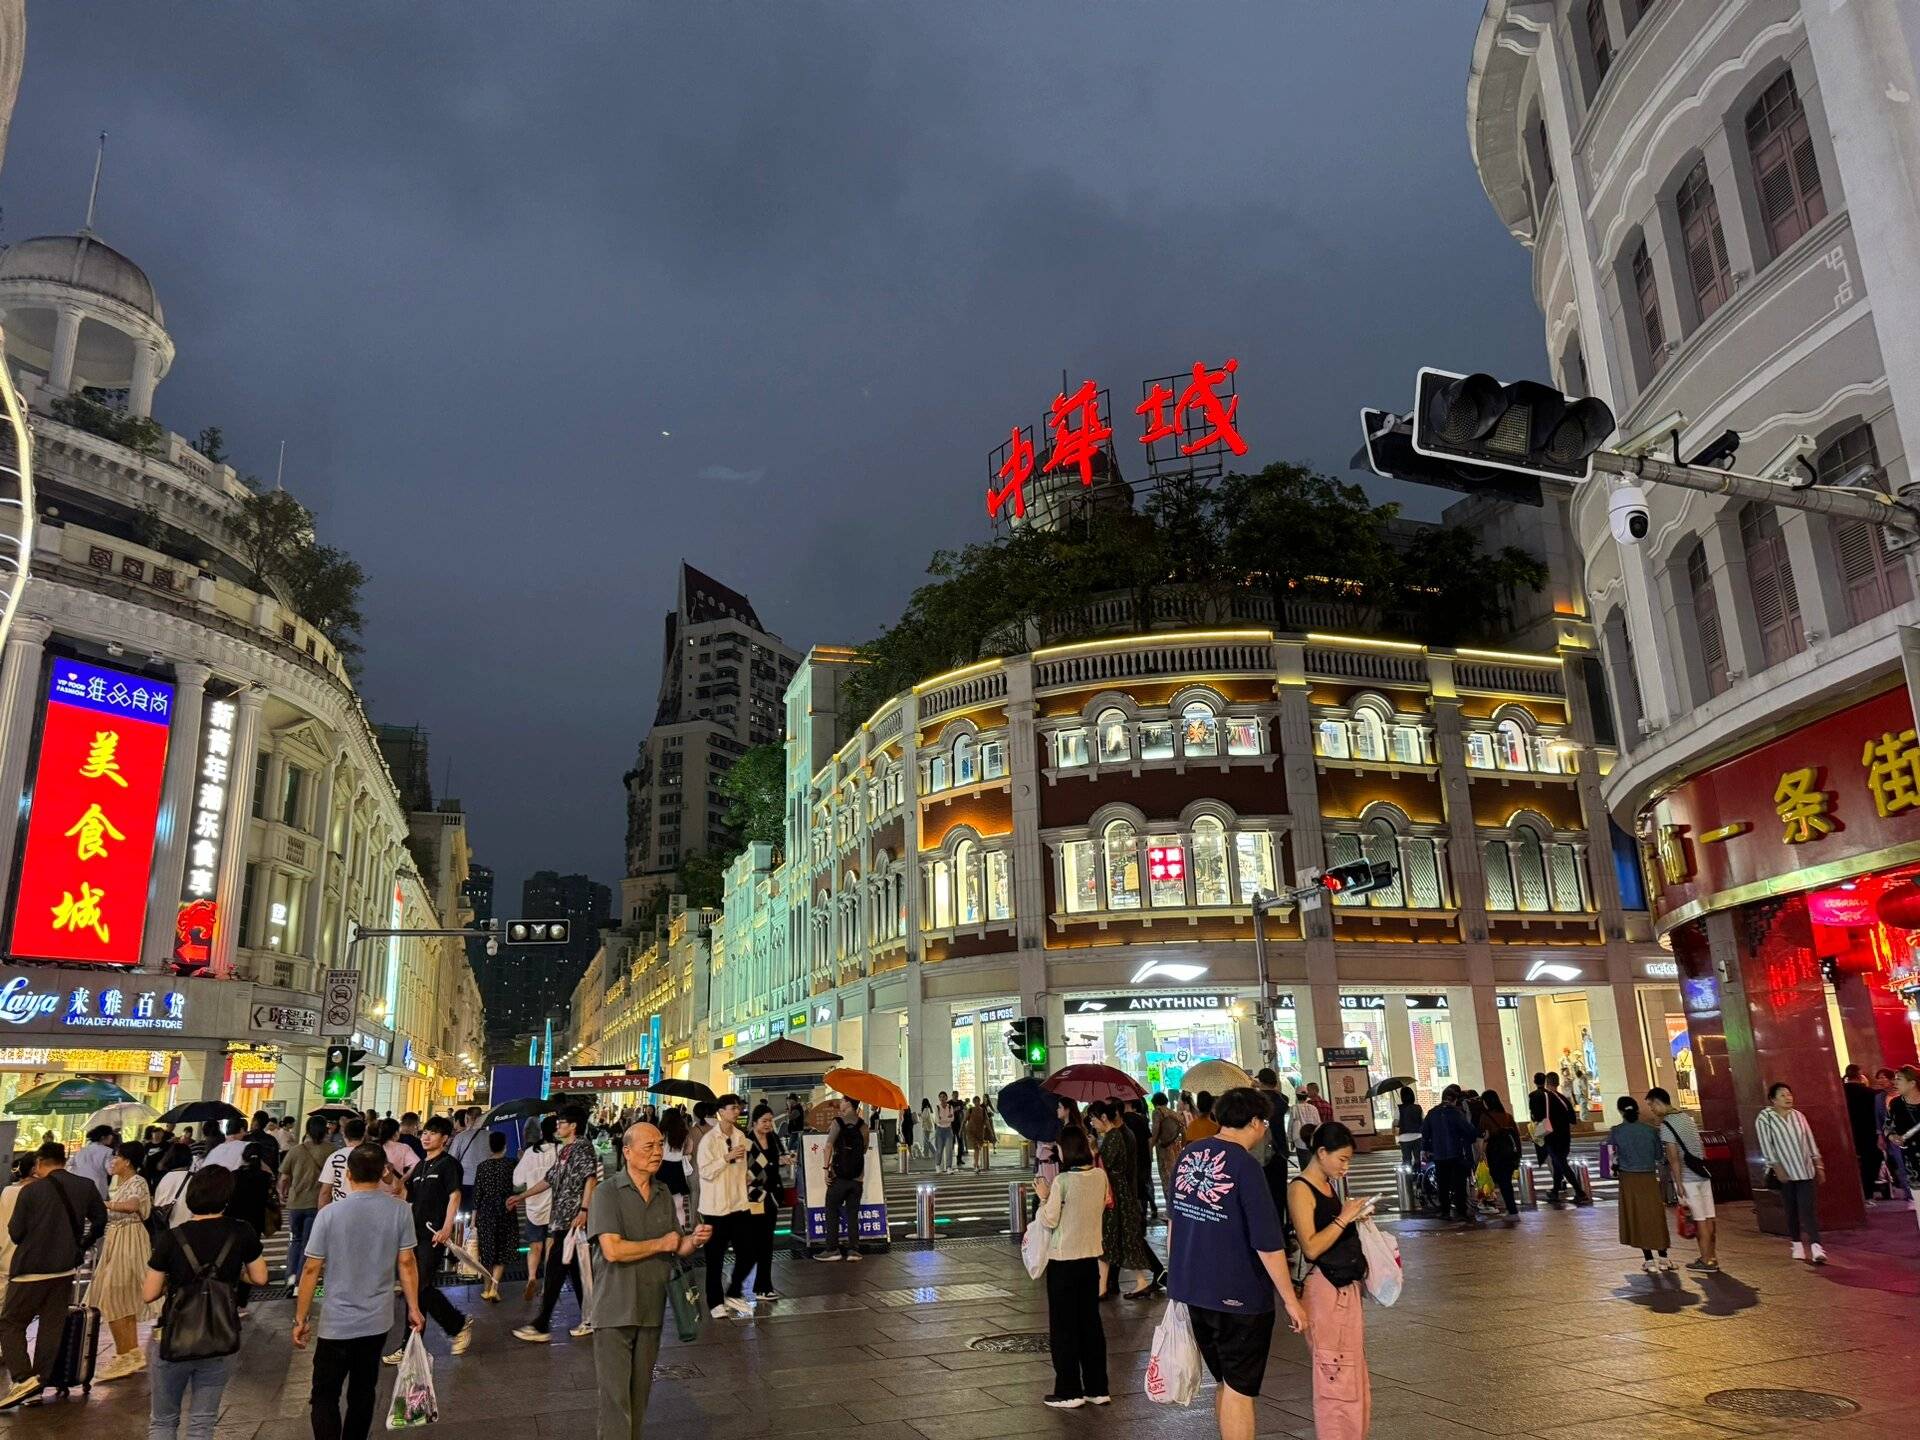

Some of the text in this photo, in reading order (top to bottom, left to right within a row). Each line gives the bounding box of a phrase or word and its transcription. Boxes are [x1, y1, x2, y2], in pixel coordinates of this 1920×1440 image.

[68, 681, 86, 690] FOOD
[56, 686, 85, 698] FASHION
[51, 730, 129, 944] 美食城
[70, 987, 185, 1018] 来雅百货
[1128, 997, 1219, 1009] ANYTHING
[66, 1016, 94, 1026] LAIYA
